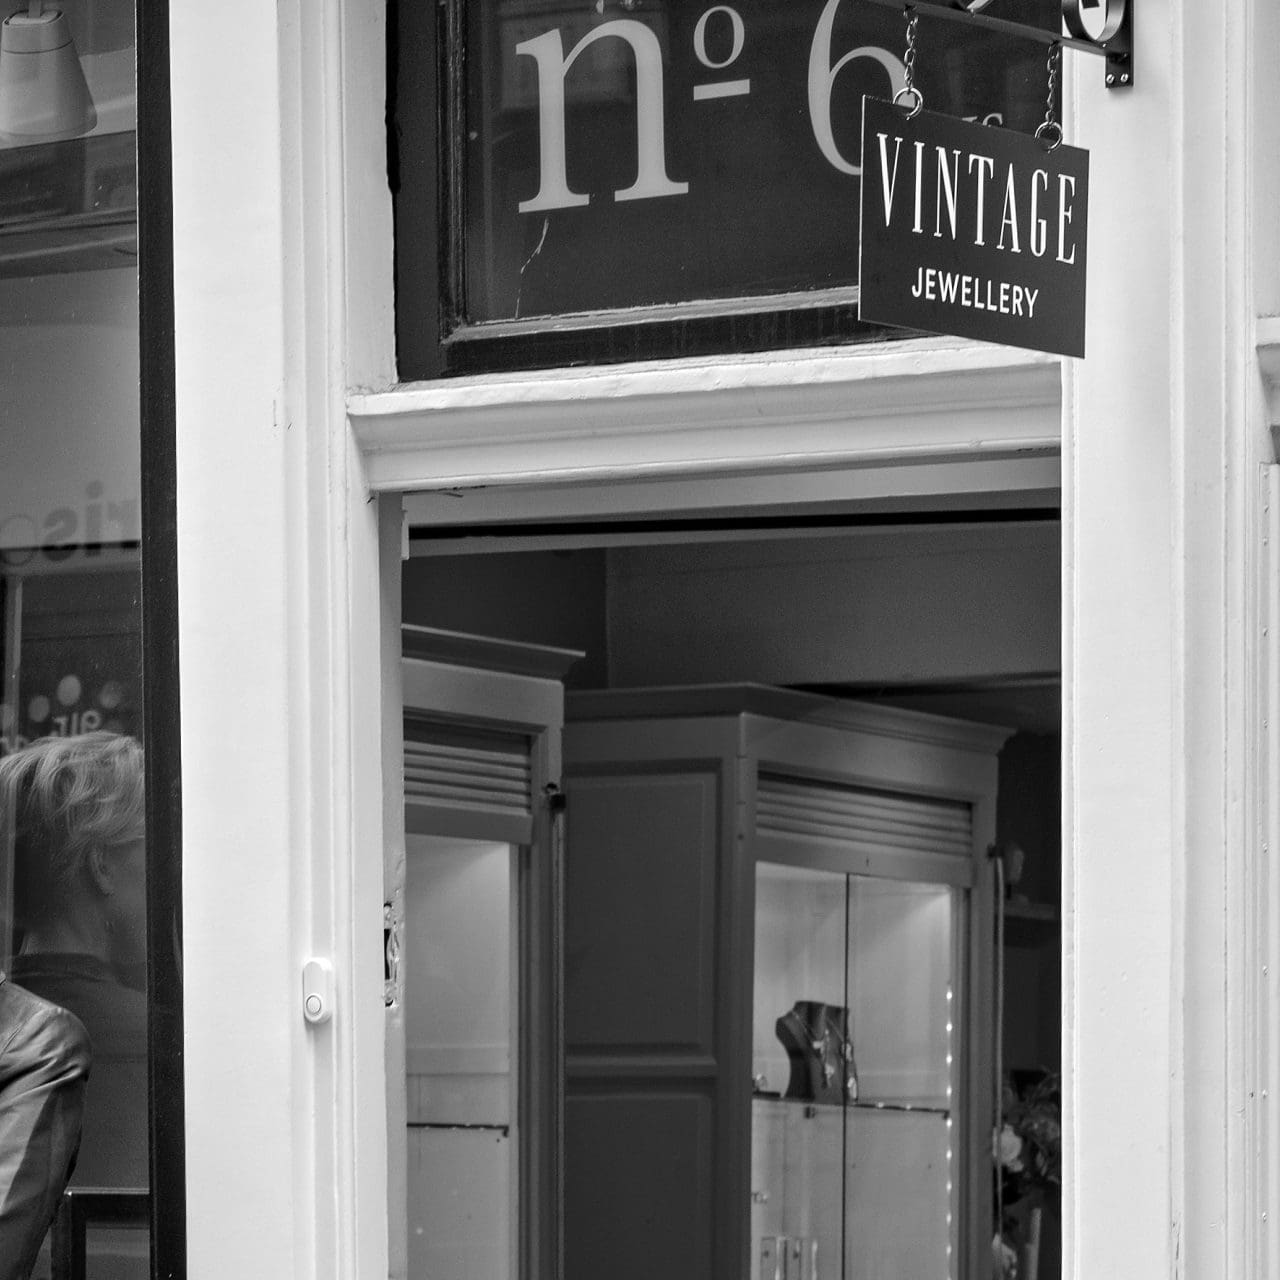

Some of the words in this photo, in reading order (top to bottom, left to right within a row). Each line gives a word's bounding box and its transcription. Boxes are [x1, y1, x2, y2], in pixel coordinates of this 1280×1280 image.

[808, 0, 916, 175] 6
[876, 132, 1076, 265] VINTAGE
[911, 267, 1039, 318] JEWELLERY
